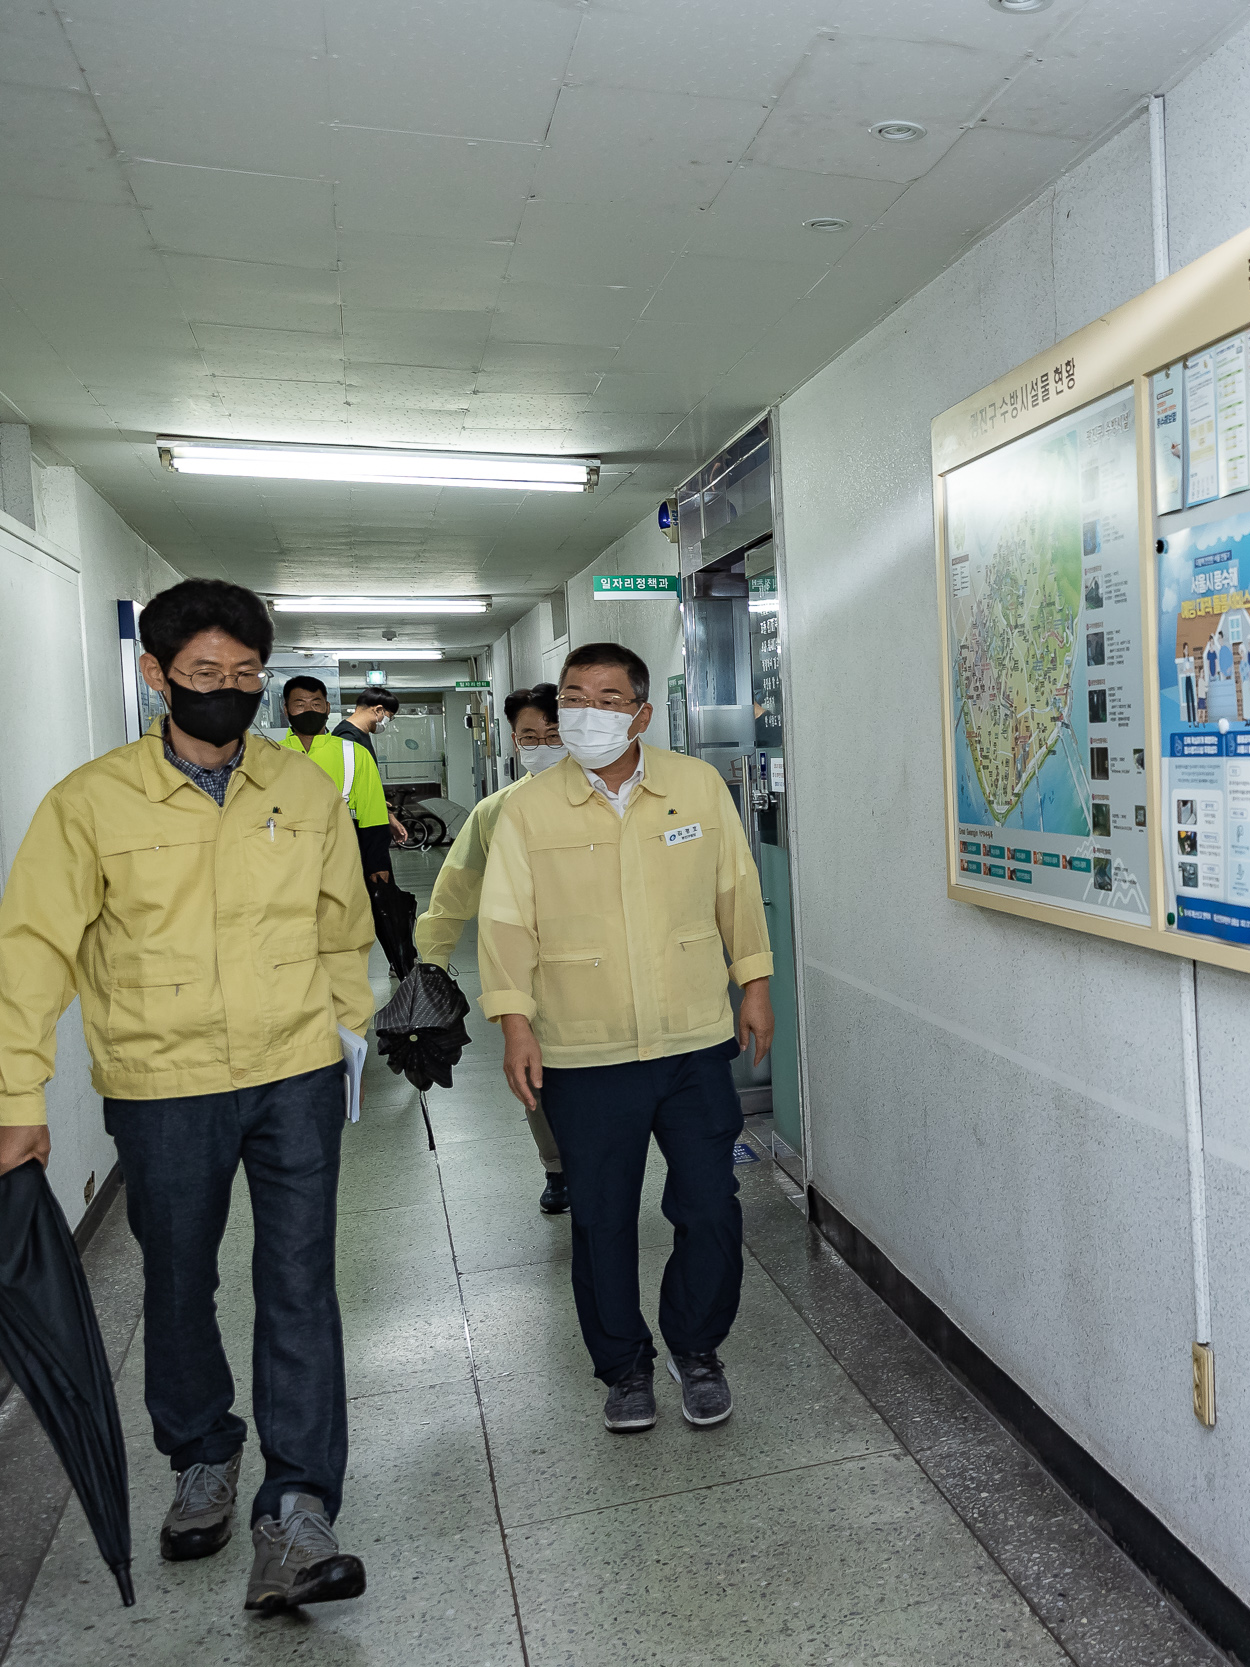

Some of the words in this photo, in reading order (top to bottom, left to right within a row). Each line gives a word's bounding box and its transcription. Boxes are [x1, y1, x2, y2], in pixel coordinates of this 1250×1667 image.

[999, 371, 1051, 424] 수방시설물
[1053, 357, 1076, 396] 현황
[600, 577, 669, 589] 일자리정책과
[1191, 572, 1214, 594] 서울시
